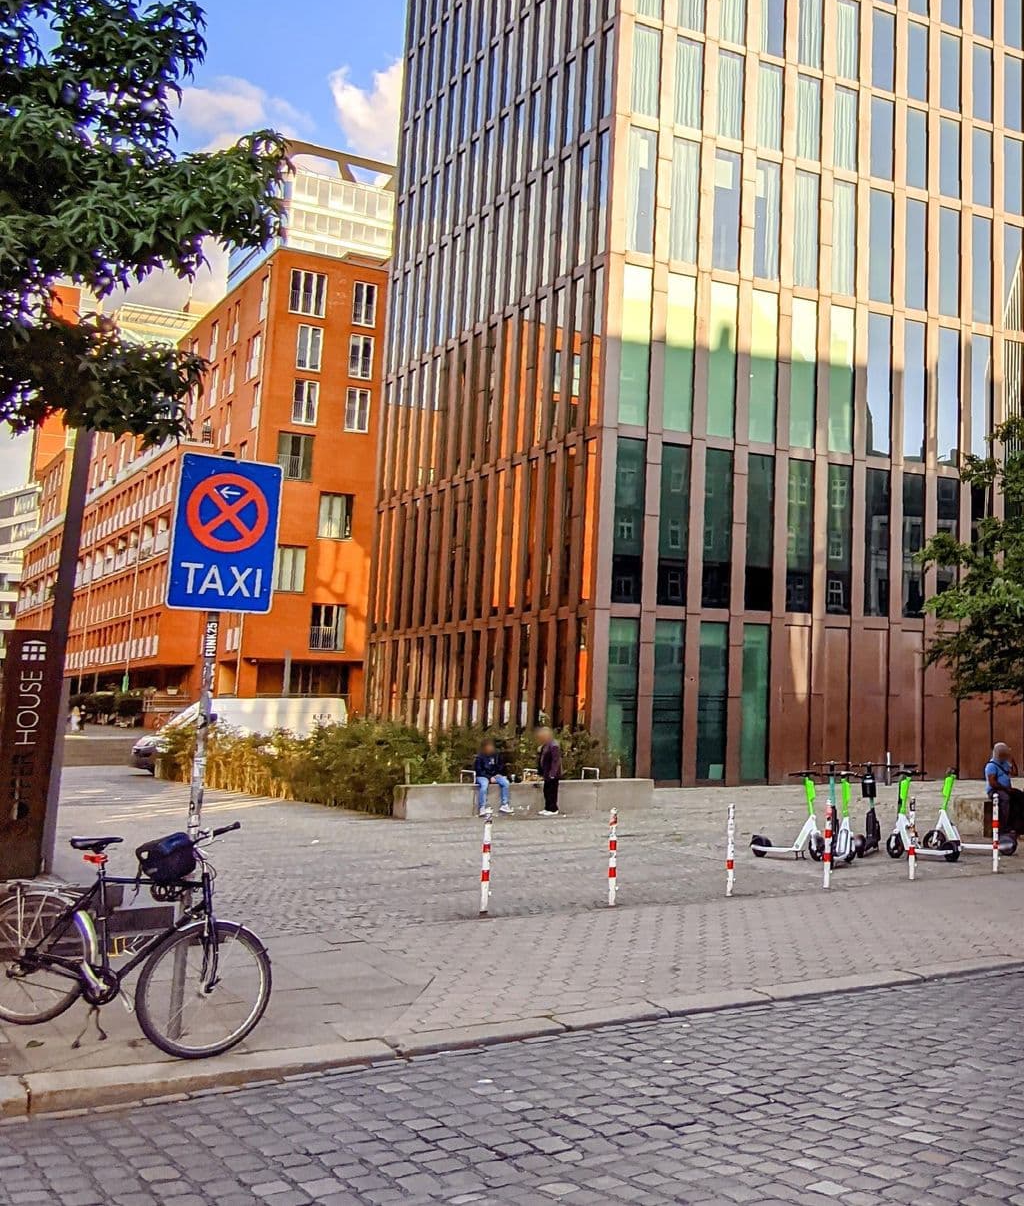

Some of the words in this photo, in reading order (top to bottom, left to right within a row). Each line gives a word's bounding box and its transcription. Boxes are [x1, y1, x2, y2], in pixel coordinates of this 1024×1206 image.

[181, 561, 263, 598] TAXI
[205, 621, 219, 658] FUNK25
[15, 670, 43, 746] HOUSE
